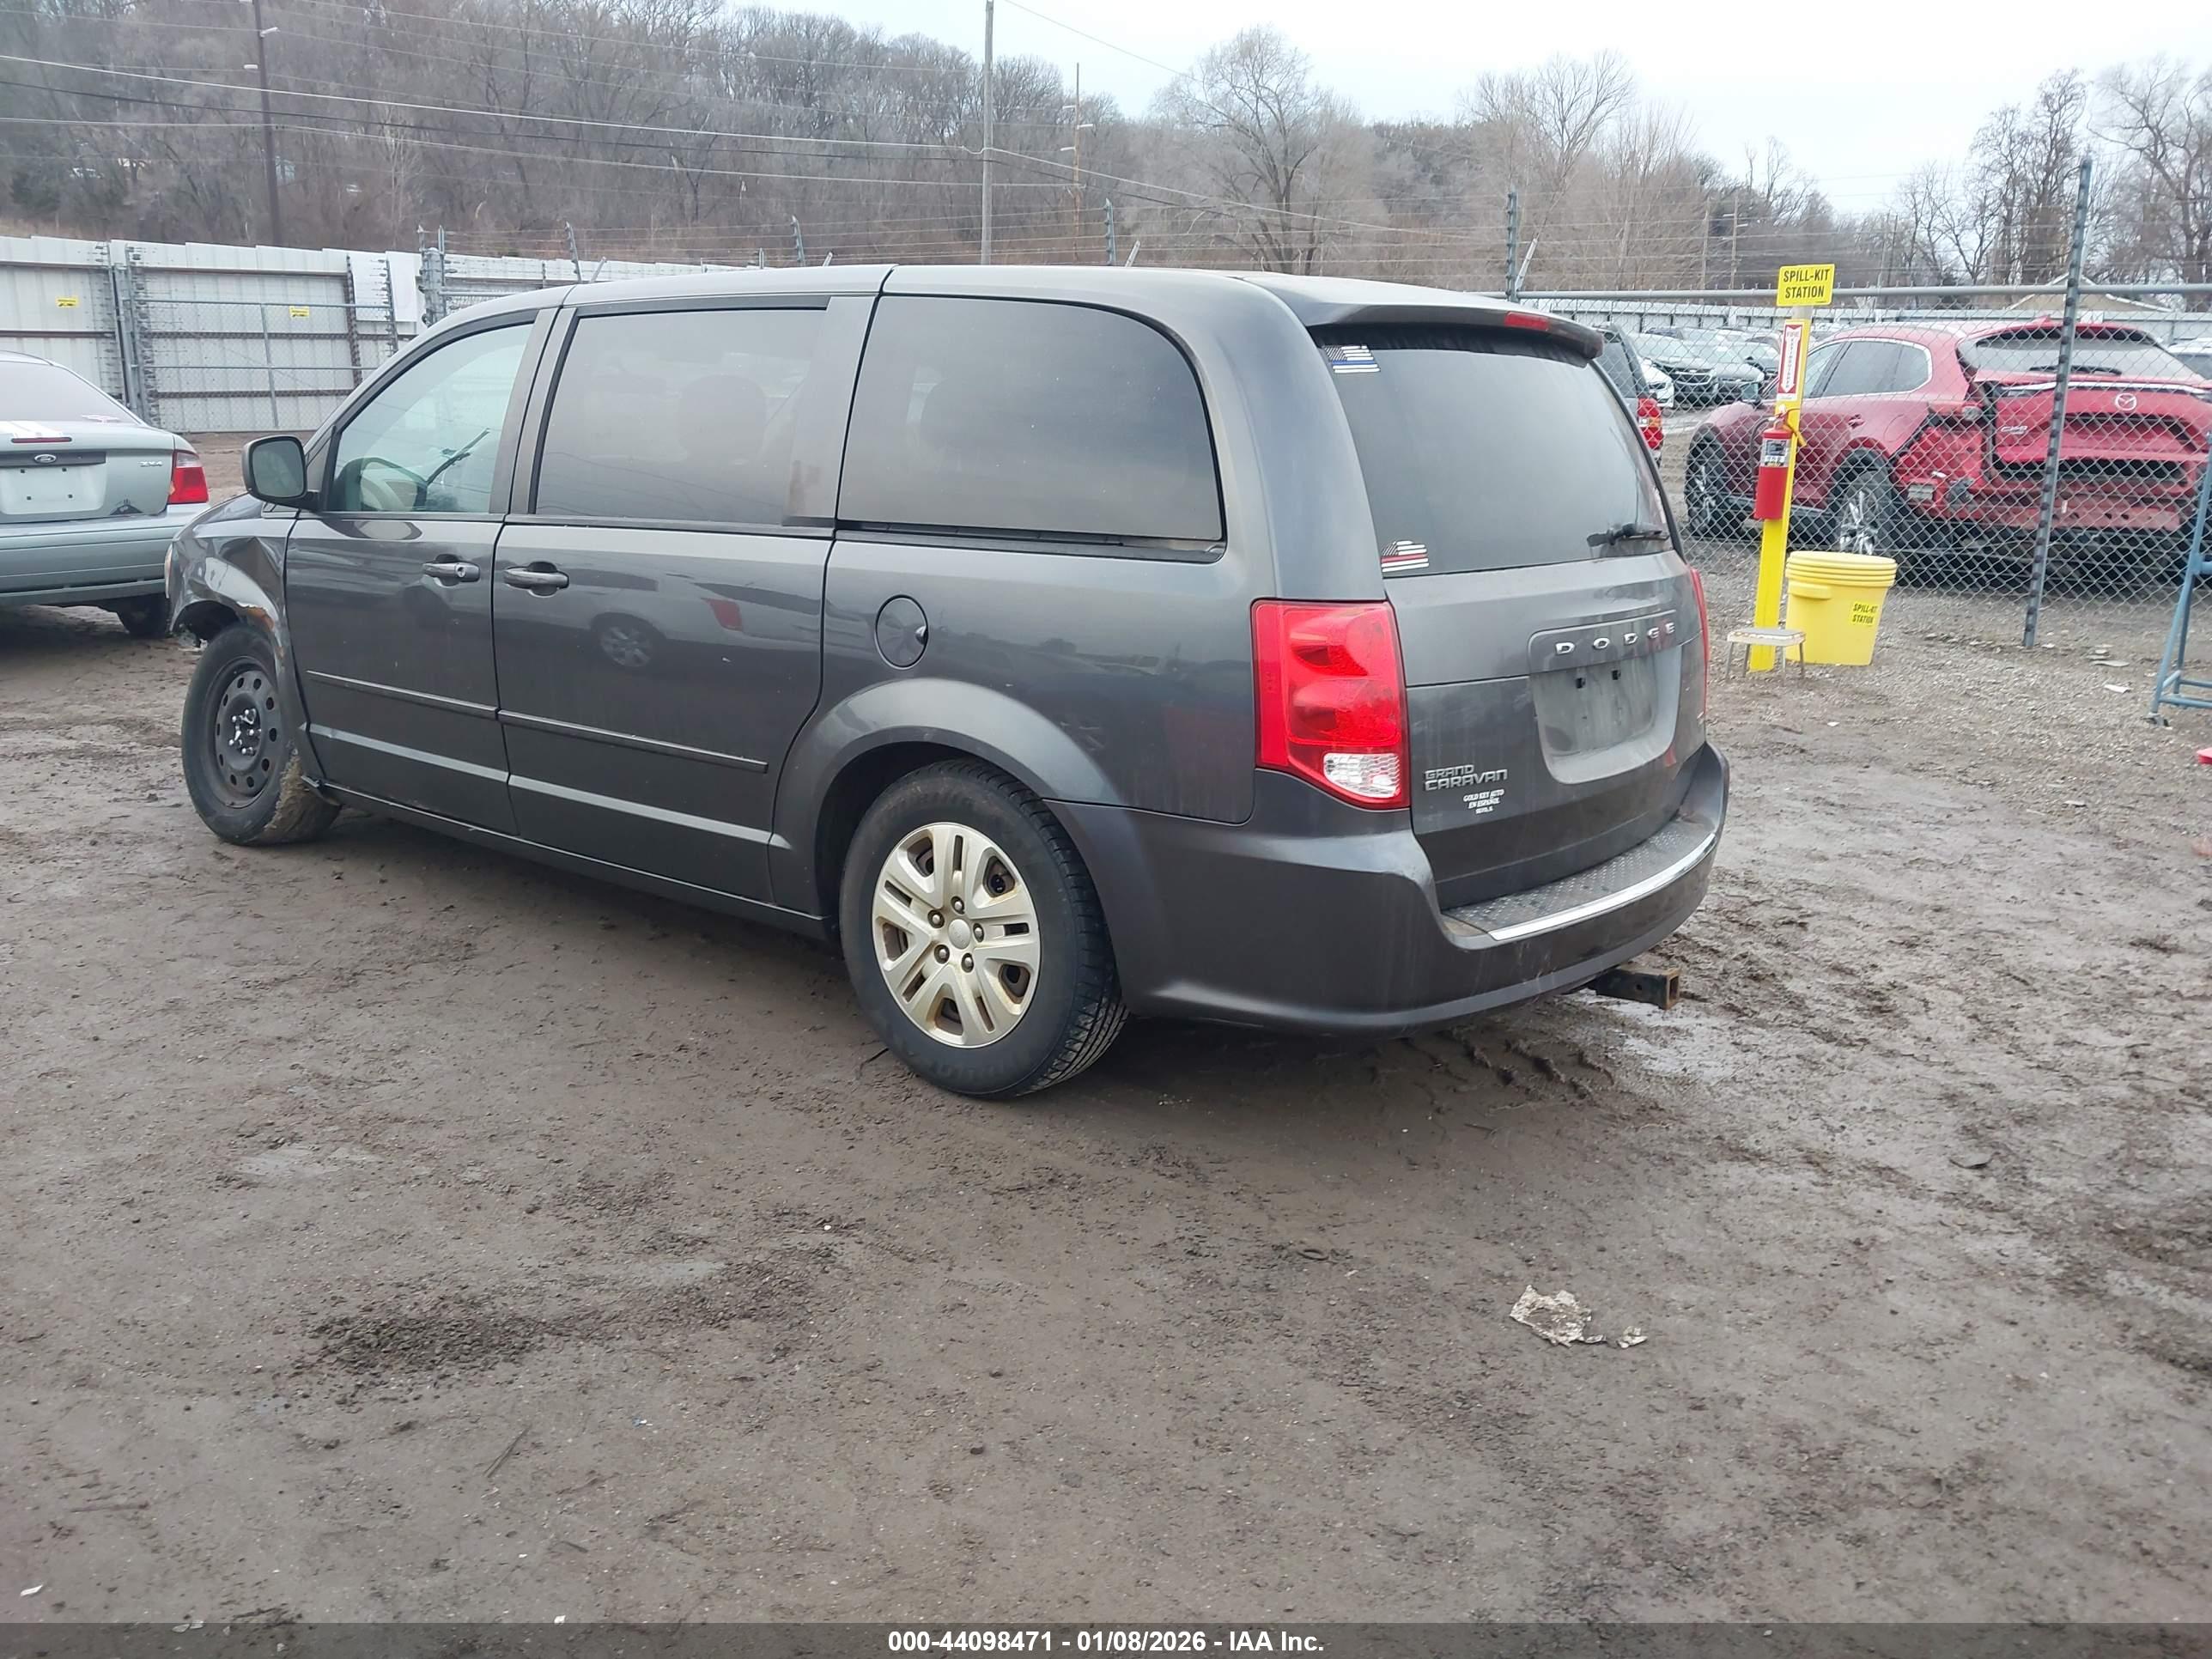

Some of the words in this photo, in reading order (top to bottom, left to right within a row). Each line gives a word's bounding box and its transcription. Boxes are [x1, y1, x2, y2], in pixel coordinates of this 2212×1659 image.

[1783, 268, 1831, 283] SPILL-KIT
[1785, 285, 1825, 299] STATION
[1852, 614, 1874, 624] STATION
[1555, 622, 1675, 655] DODGE
[1425, 764, 1474, 780] GRAND
[1425, 769, 1508, 791] CARAVAN
